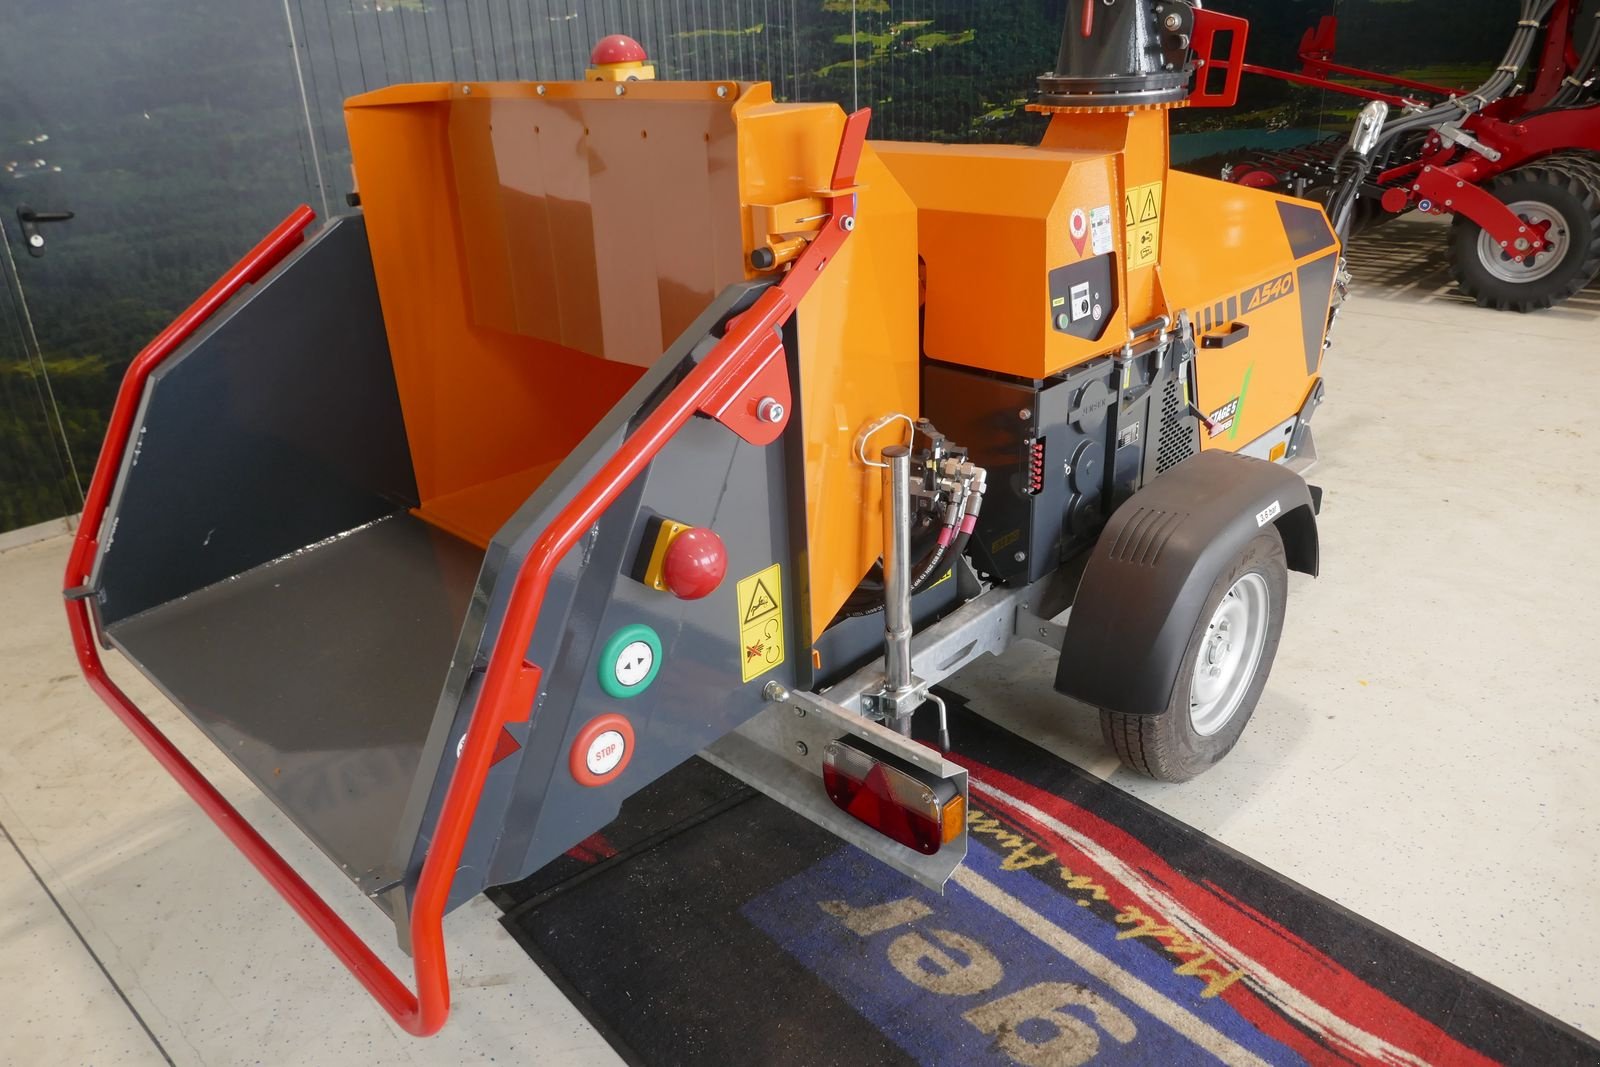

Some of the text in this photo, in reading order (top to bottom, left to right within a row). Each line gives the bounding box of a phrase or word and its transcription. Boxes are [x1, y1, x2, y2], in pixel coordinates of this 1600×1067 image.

[1247, 274, 1292, 311] A540
[1269, 505, 1277, 516] bar
[595, 743, 616, 761] STOP
[1060, 865, 1109, 907] in
[1115, 904, 1245, 999] Made
[816, 896, 1137, 1067] ger
